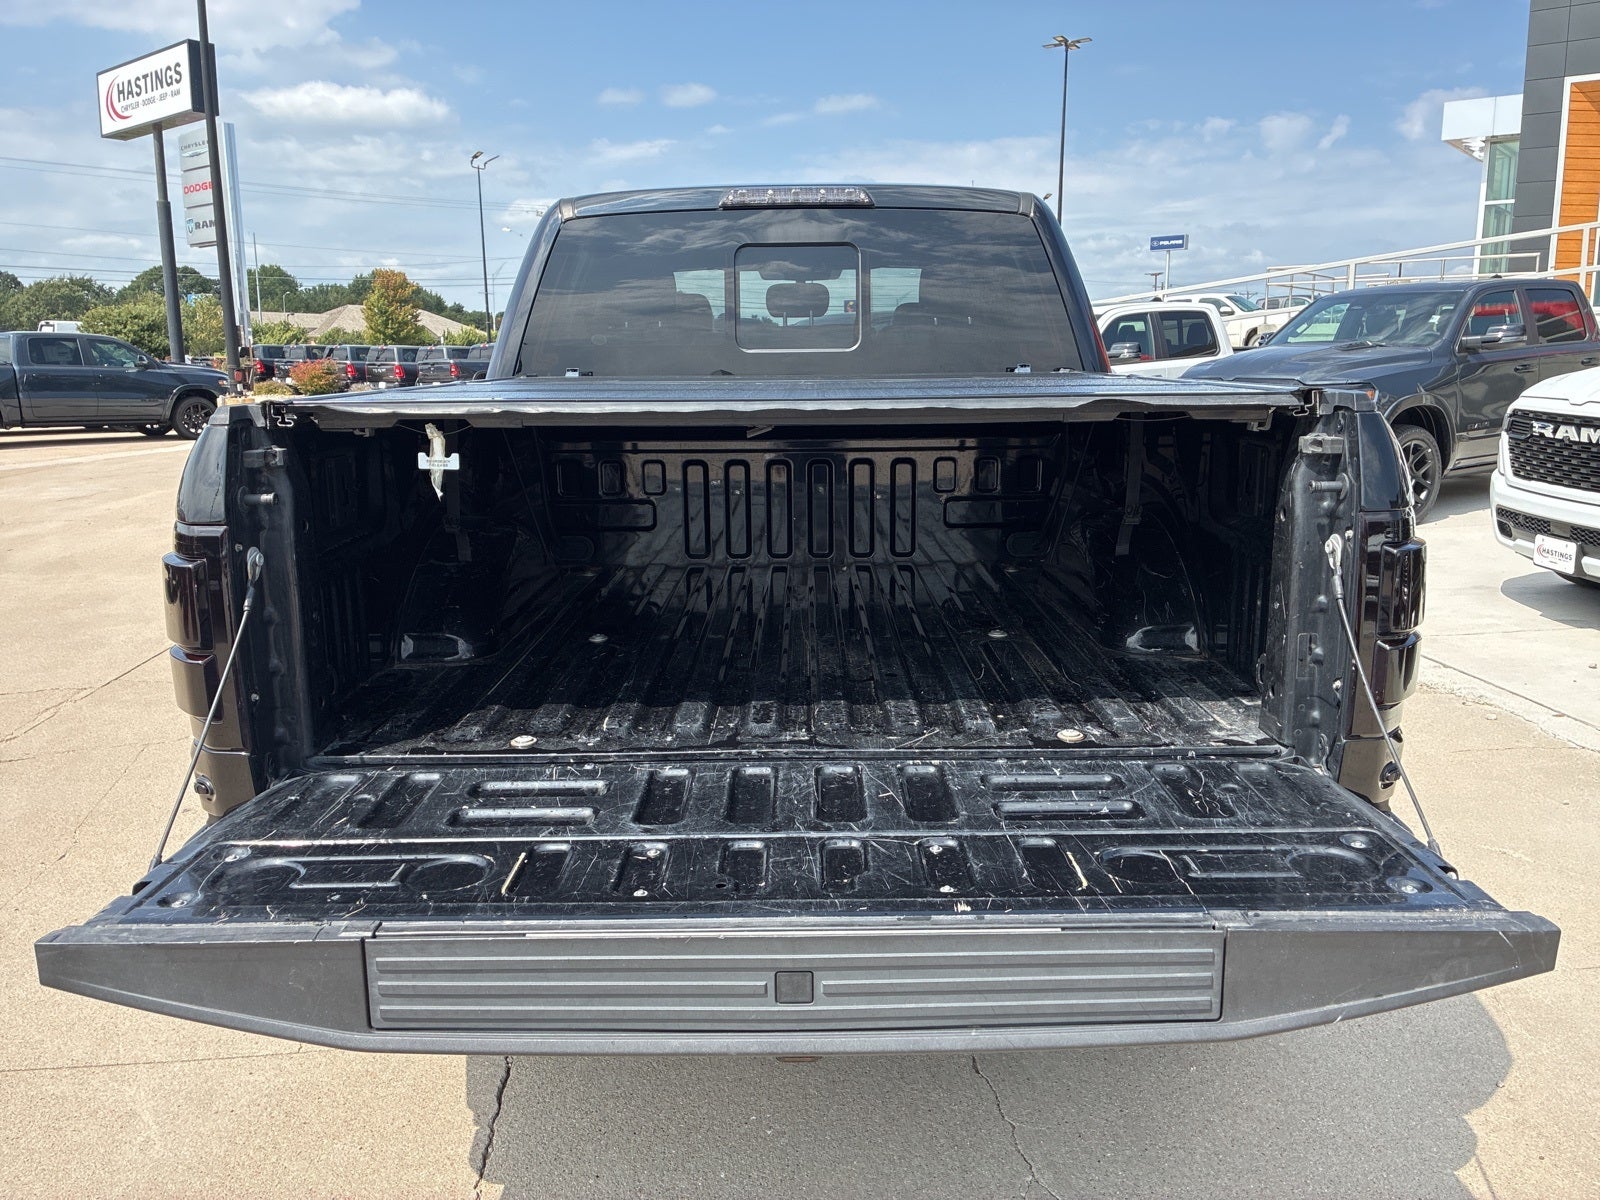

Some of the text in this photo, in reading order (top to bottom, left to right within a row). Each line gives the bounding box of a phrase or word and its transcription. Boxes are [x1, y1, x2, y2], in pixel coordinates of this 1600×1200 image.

[117, 62, 182, 103] HASTINGS
[120, 101, 140, 113] CHRYSLER
[180, 140, 208, 150] CHRYSLE
[1541, 547, 1573, 561] HASTINGS
